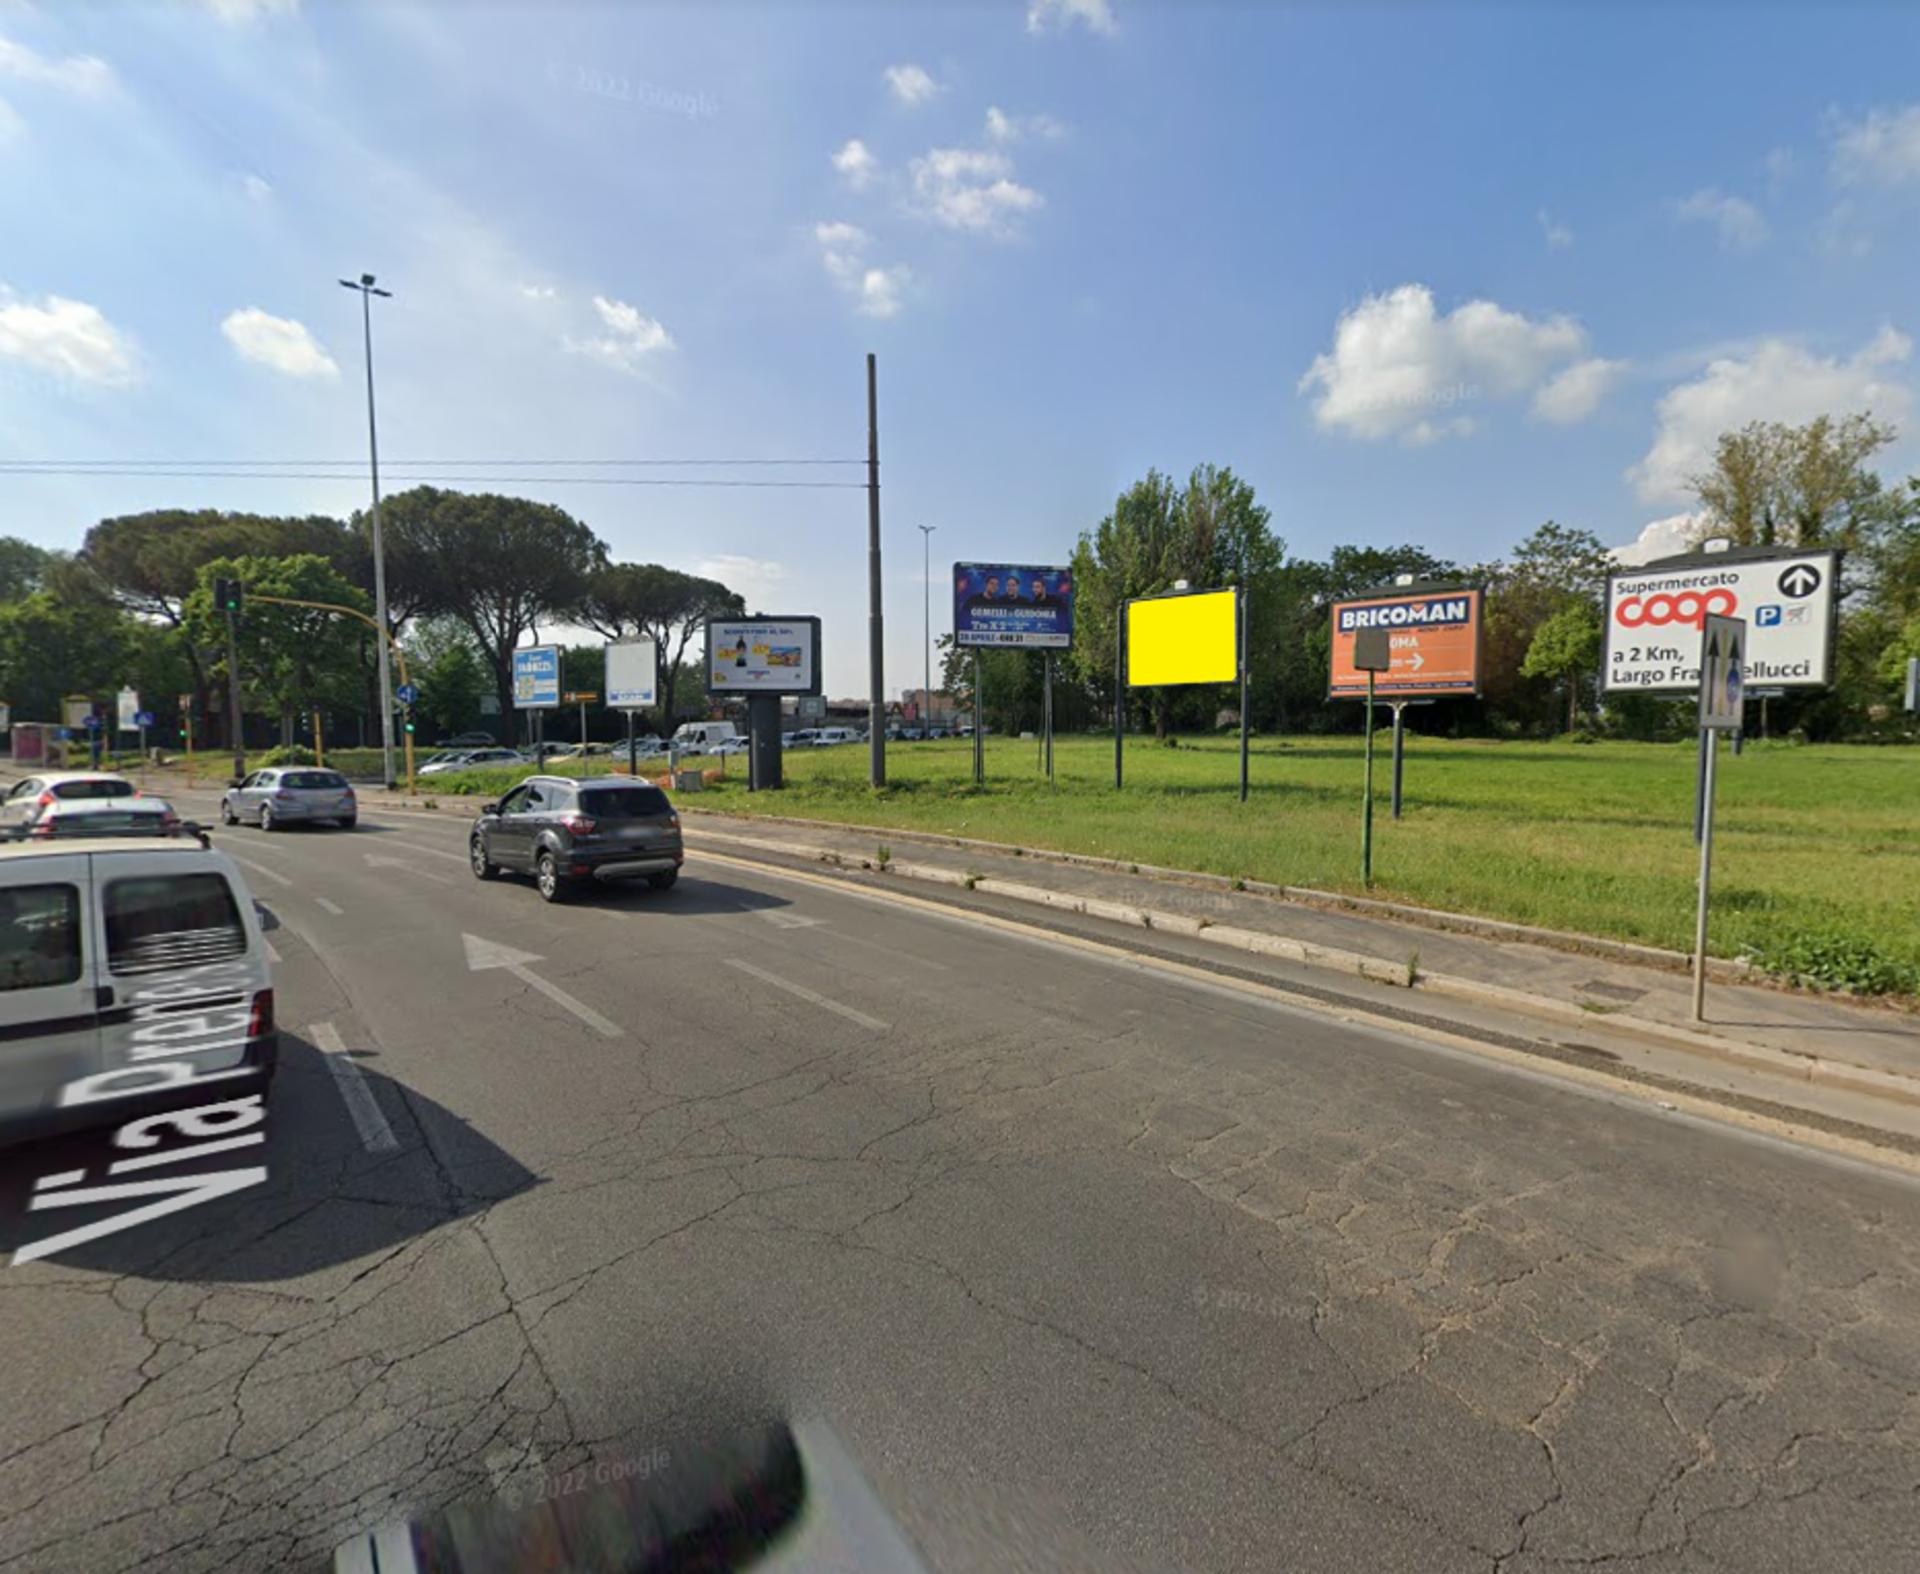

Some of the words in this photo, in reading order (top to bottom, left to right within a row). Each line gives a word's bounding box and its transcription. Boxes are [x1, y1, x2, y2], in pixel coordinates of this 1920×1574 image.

[1616, 572, 1740, 595] Supermercato
[1341, 601, 1466, 629] BRICOMAN
[1612, 650, 1625, 664] a
[1629, 646, 1642, 663] 2
[1645, 645, 1685, 663] Km,
[1611, 668, 1665, 687] Largo
[1670, 659, 1810, 682] Fraellucci
